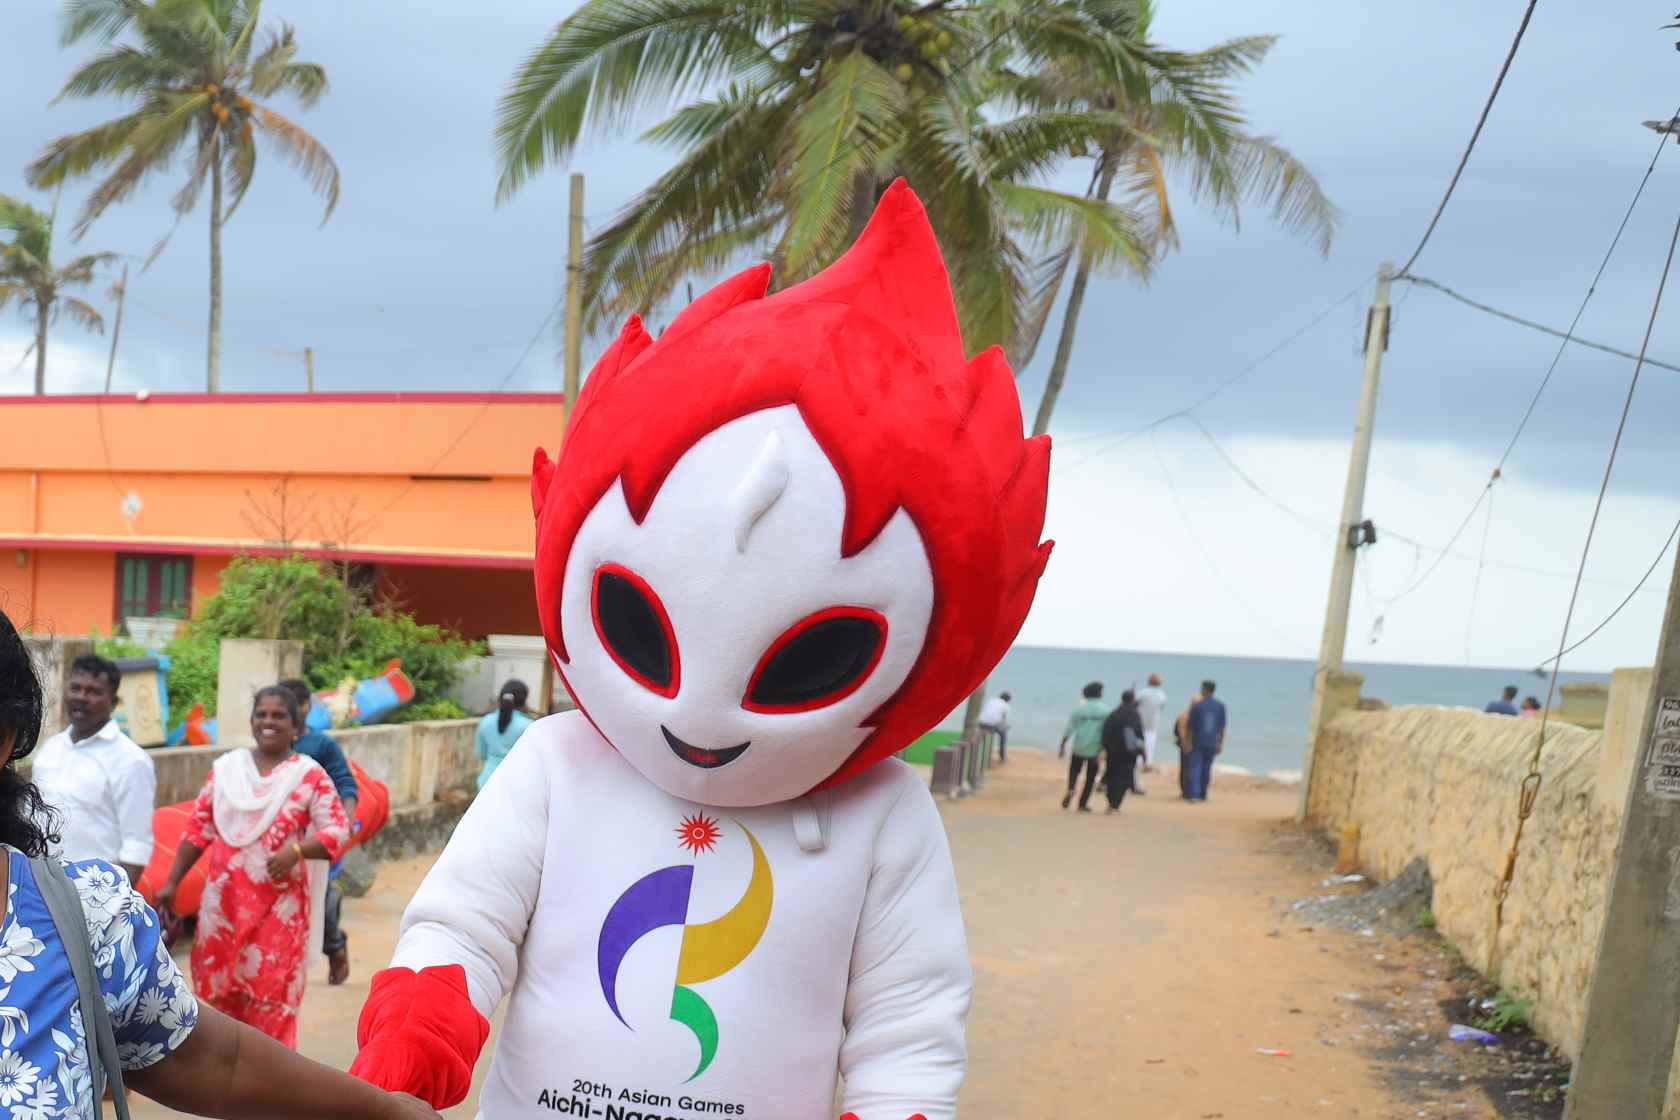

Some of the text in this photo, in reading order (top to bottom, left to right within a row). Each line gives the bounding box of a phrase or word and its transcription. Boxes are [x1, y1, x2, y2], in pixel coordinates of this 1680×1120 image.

[572, 1079, 745, 1116] 20th Asian Games
